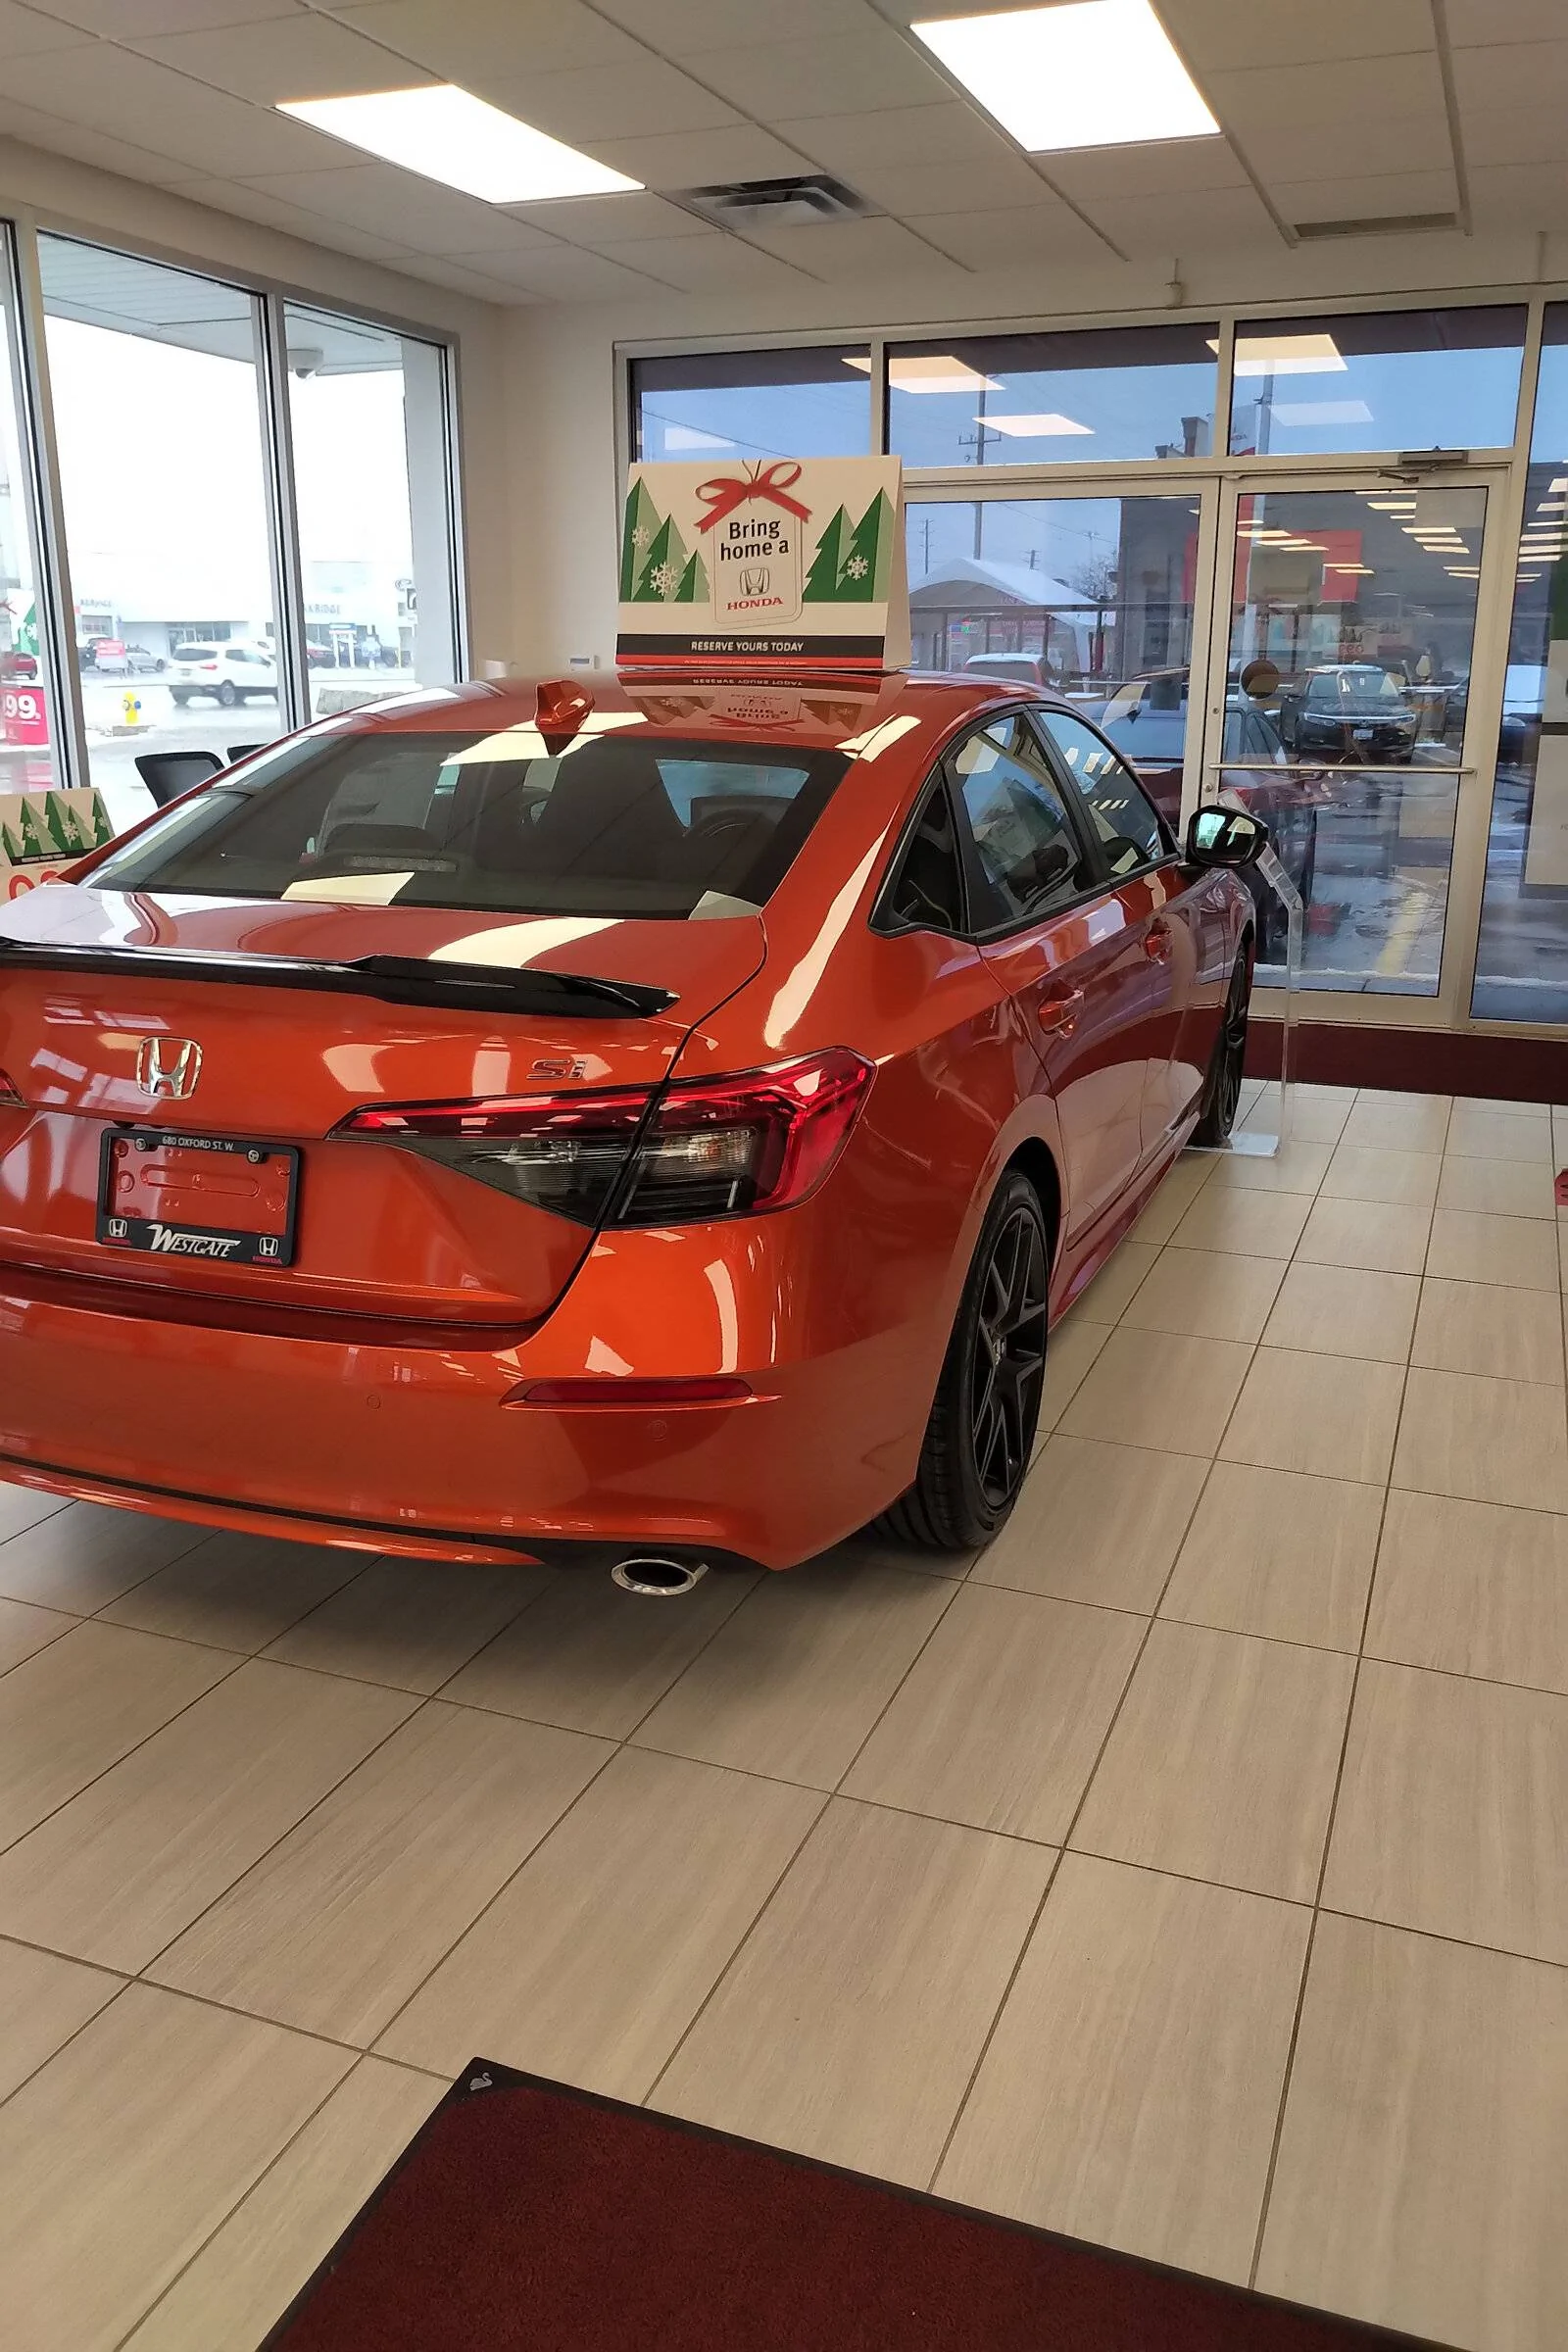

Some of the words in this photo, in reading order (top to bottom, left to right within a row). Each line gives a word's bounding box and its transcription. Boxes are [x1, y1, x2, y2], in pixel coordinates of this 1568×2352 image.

[729, 519, 781, 540] Bring
[720, 542, 772, 562] home
[778, 539, 789, 554] a
[727, 597, 783, 610] HONDA
[691, 641, 734, 652] RESERVE
[736, 642, 768, 652] YOURS
[771, 642, 804, 652] TODAY
[525, 1058, 587, 1079] Si
[162, 1135, 175, 1145] 680
[177, 1137, 212, 1150] OXFORD
